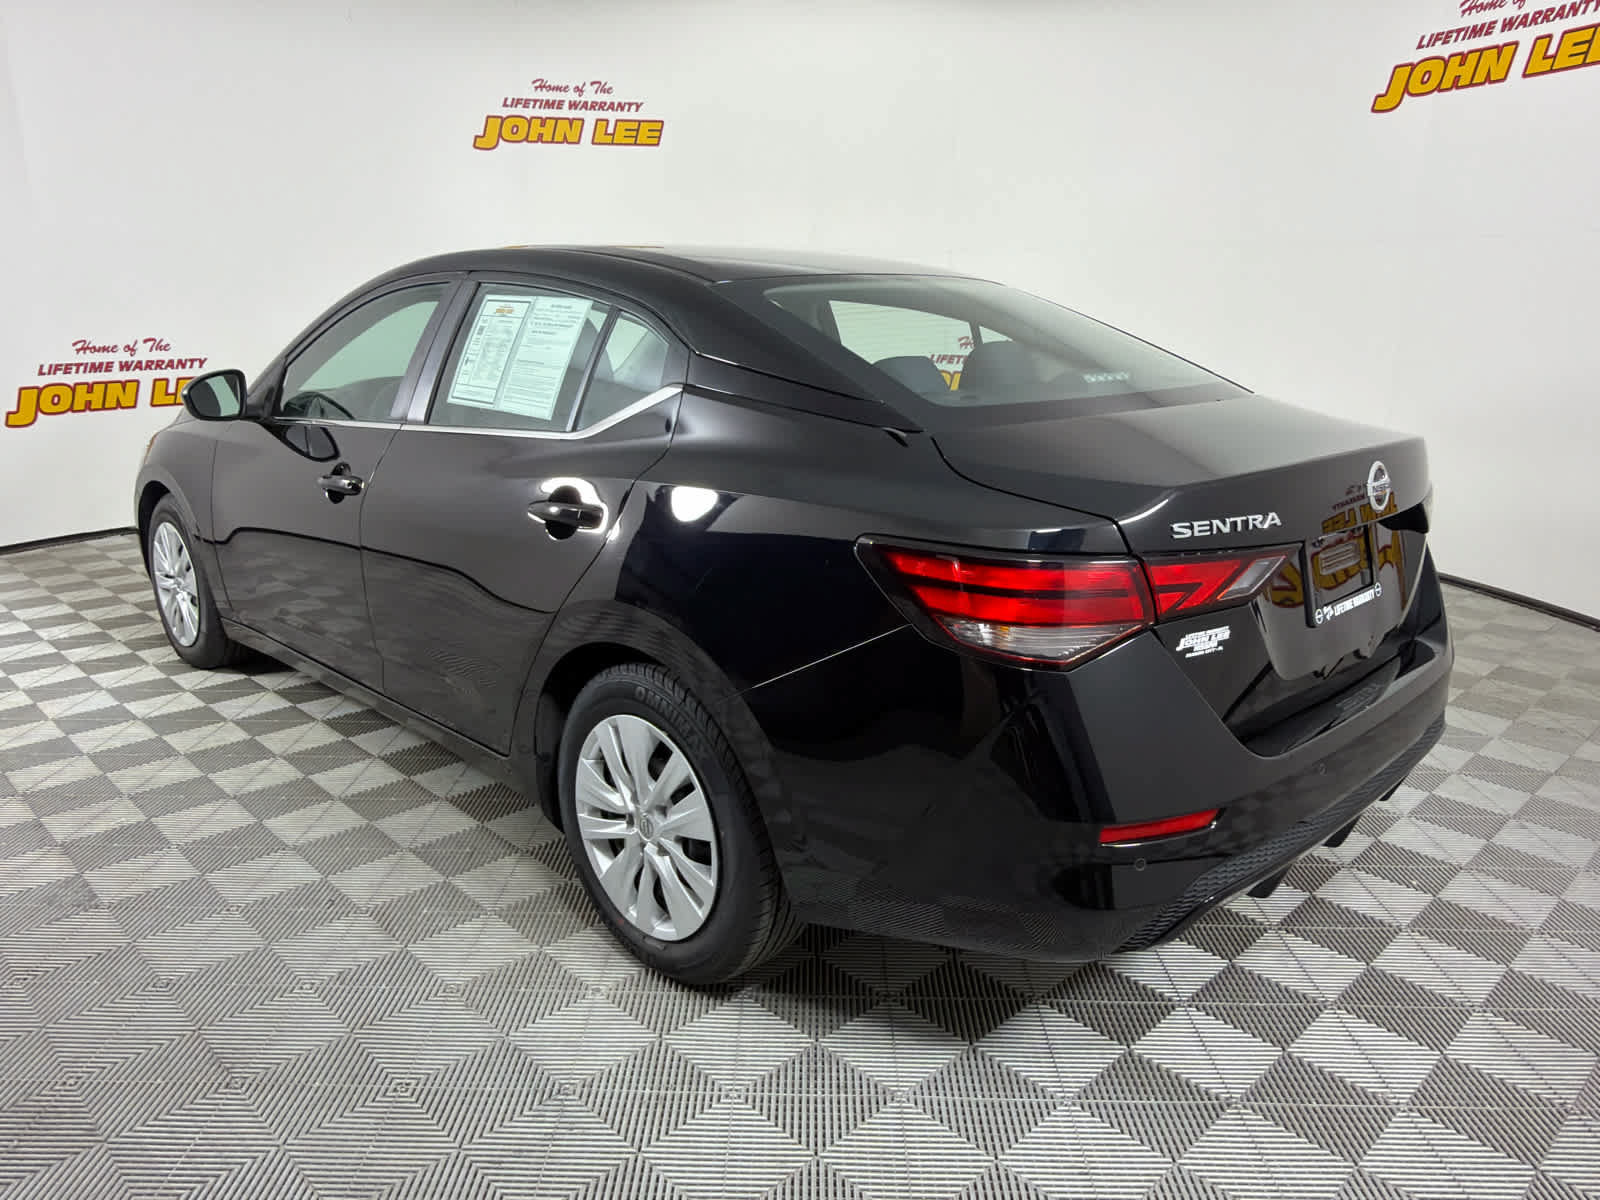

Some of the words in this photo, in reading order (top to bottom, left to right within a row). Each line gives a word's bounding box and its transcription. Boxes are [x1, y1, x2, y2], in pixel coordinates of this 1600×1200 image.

[1416, 20, 1498, 50] LIFETIME
[531, 78, 570, 93] Home
[573, 82, 586, 97] of
[590, 81, 613, 94] The
[1371, 41, 1519, 113] JOHN
[502, 97, 565, 110] LIFETIME
[568, 100, 644, 112] WARRANTY
[473, 115, 584, 150] JOHN
[591, 118, 664, 147] LEE
[72, 339, 119, 355] Home
[123, 340, 138, 357] of
[143, 338, 171, 352] The
[929, 354, 967, 364] LIFET
[38, 359, 114, 376] LIFETIME
[118, 358, 208, 373] WARRANTY
[5, 379, 140, 428] JOHN
[1172, 512, 1281, 539] SENTRA
